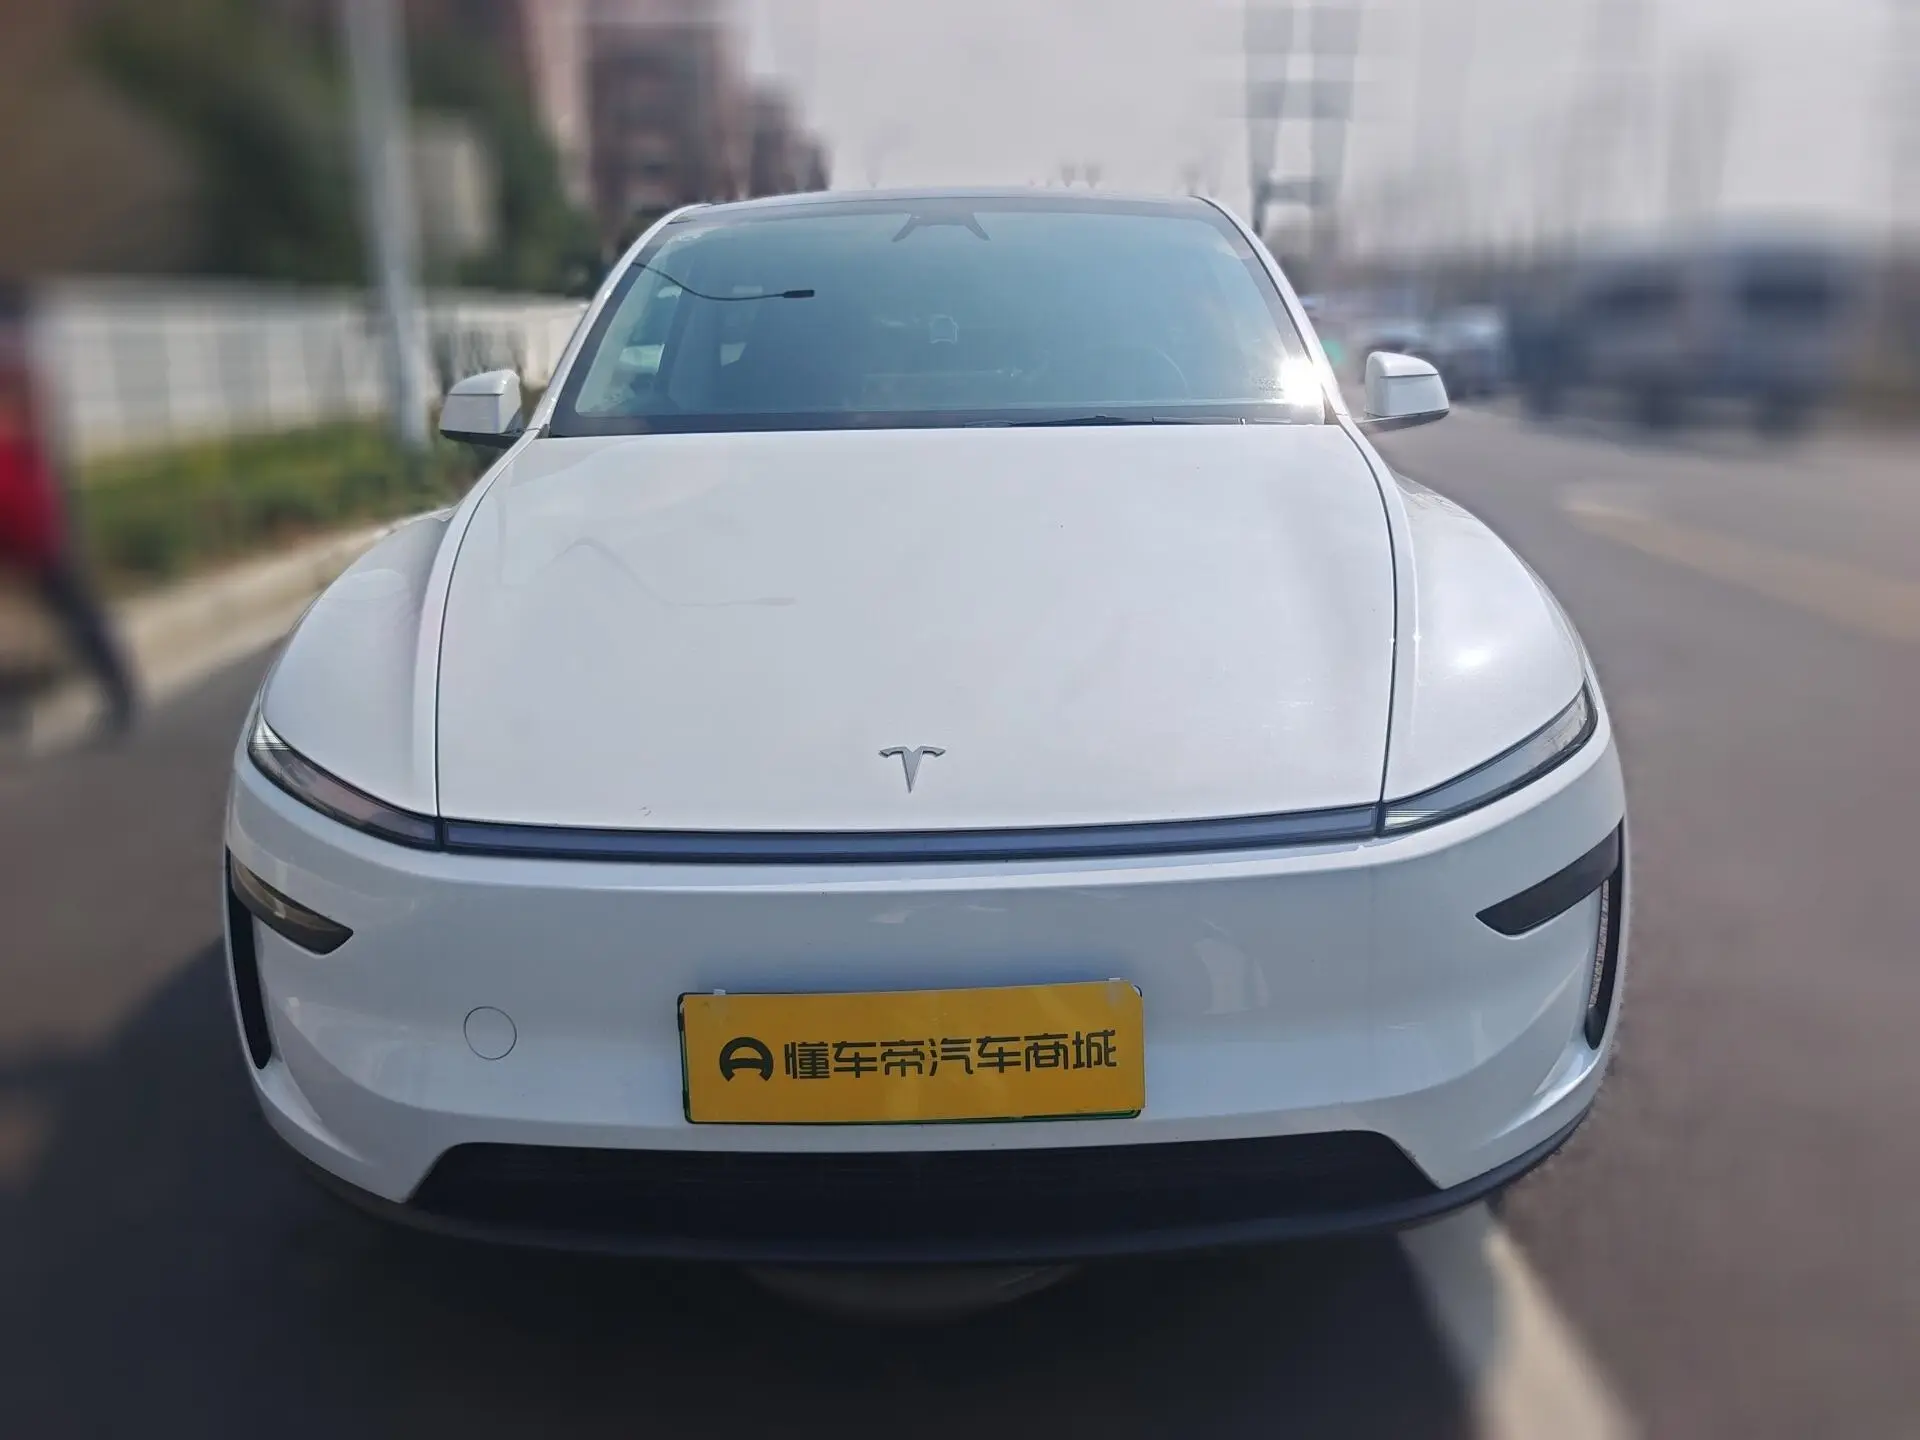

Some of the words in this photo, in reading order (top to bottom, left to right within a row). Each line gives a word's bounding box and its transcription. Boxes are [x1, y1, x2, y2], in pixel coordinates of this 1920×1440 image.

[784, 1029, 1117, 1080] 懂车帝汽车商城
